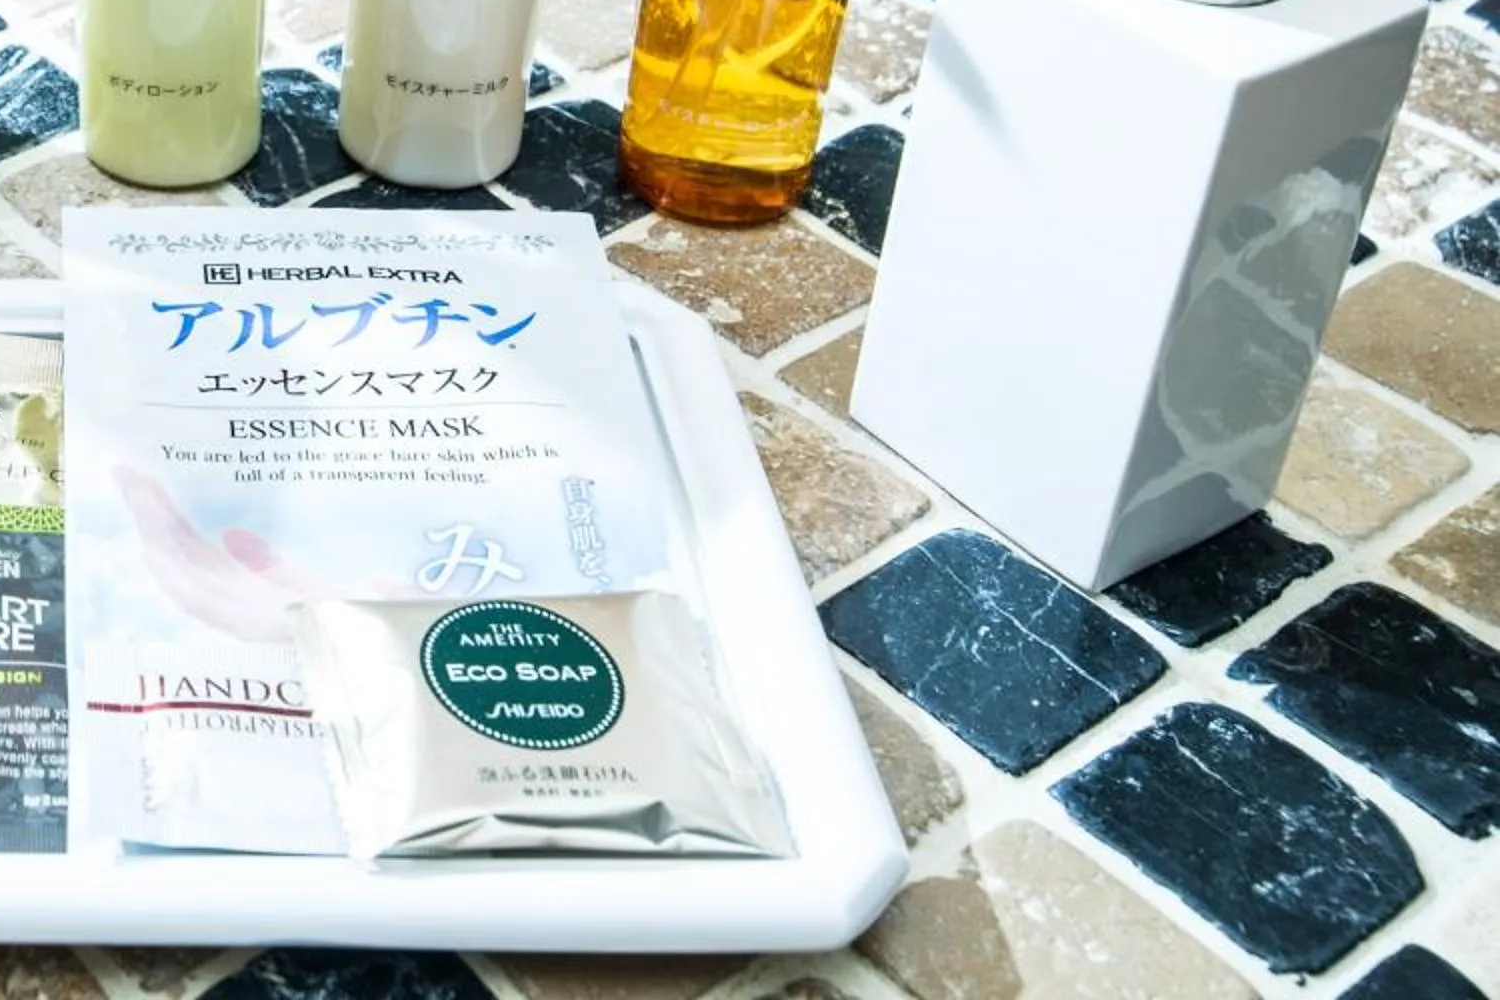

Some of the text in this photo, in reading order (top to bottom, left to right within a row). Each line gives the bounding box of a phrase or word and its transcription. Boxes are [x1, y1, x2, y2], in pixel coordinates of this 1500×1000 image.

[385, 73, 510, 98] モイスチャーミルク
[248, 265, 362, 282] HERBAL
[368, 266, 464, 284] EXTRA
[151, 291, 538, 354] アルブチン
[198, 366, 500, 397] エッセンスマスク
[228, 415, 485, 441] ESSENCE MASK
[160, 444, 197, 462] You
[203, 451, 233, 463] are
[239, 450, 265, 463] led
[273, 451, 291, 463] to
[297, 449, 326, 462] the
[391, 449, 431, 462] bare
[437, 449, 475, 463] skin
[483, 445, 537, 461] which
[543, 444, 560, 459] is
[233, 468, 263, 482] full
[269, 468, 286, 482] of
[292, 472, 304, 482] a
[310, 470, 416, 484] transparent
[416, 522, 526, 598] み
[489, 623, 524, 634] THE
[459, 633, 560, 647] AMENITY
[446, 662, 597, 683] ECO SOAP
[15, 705, 50, 720] helps
[486, 702, 585, 719] SHISEIDO
